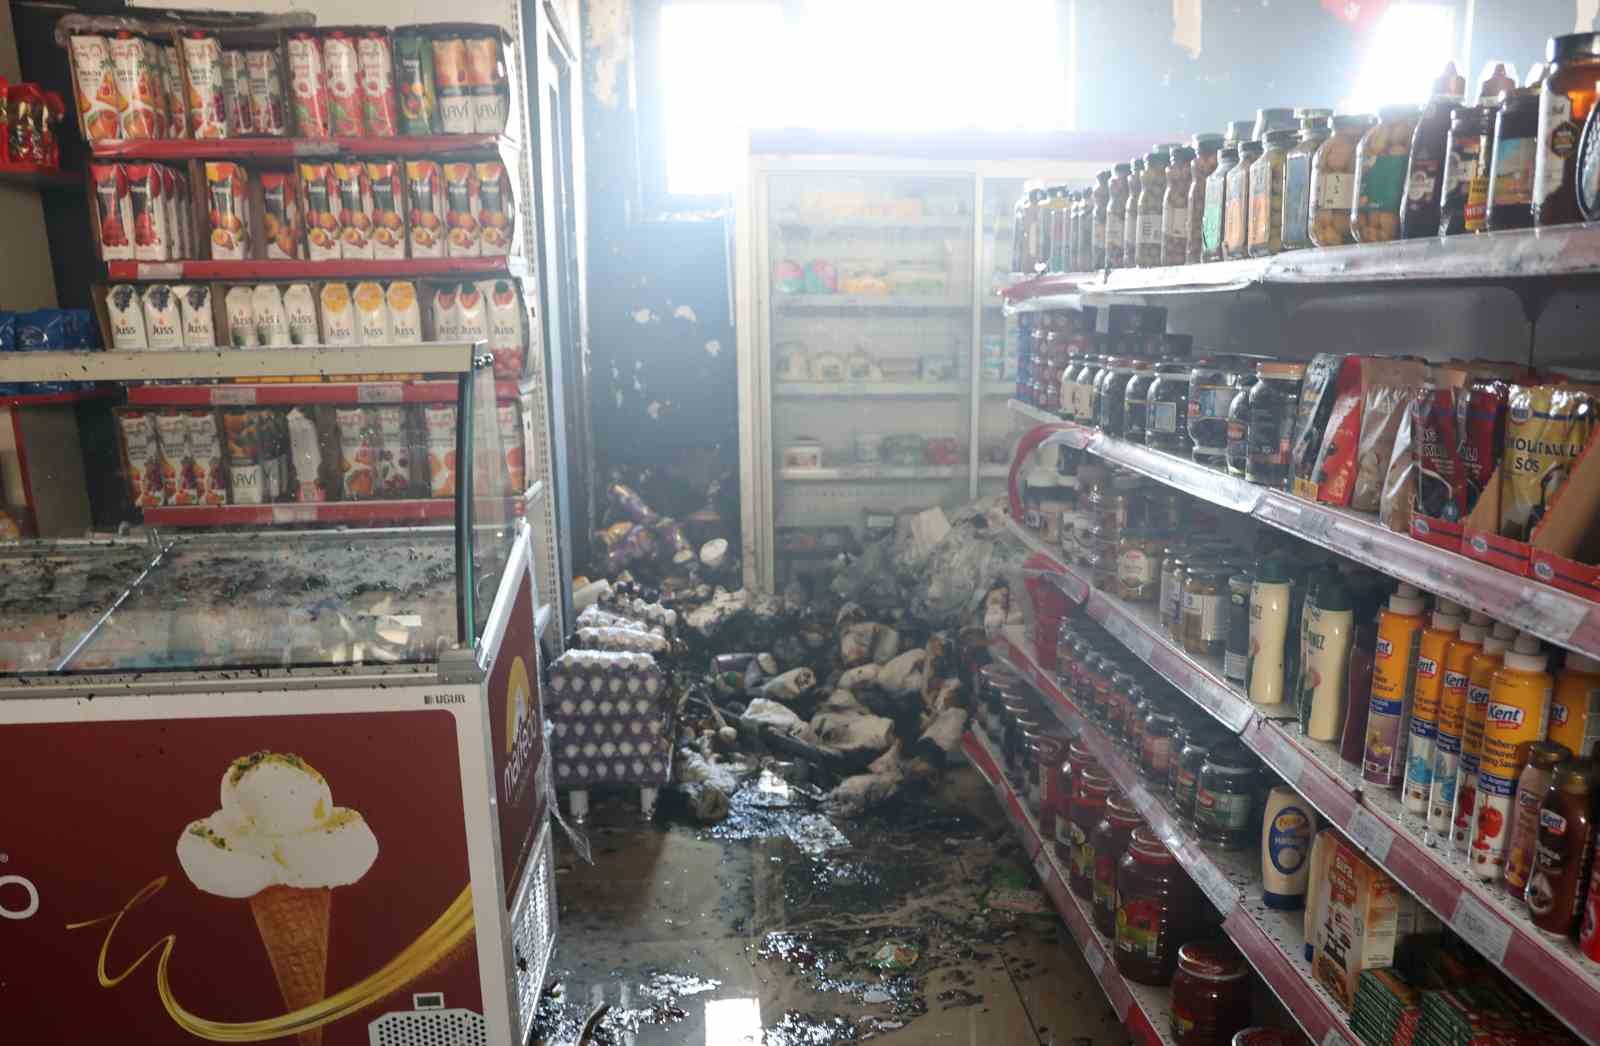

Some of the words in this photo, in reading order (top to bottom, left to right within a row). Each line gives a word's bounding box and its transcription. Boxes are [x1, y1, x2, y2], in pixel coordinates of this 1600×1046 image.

[1514, 457, 1540, 473] SOS
[1469, 687, 1489, 704] Ken
[1488, 704, 1521, 721] Kent
